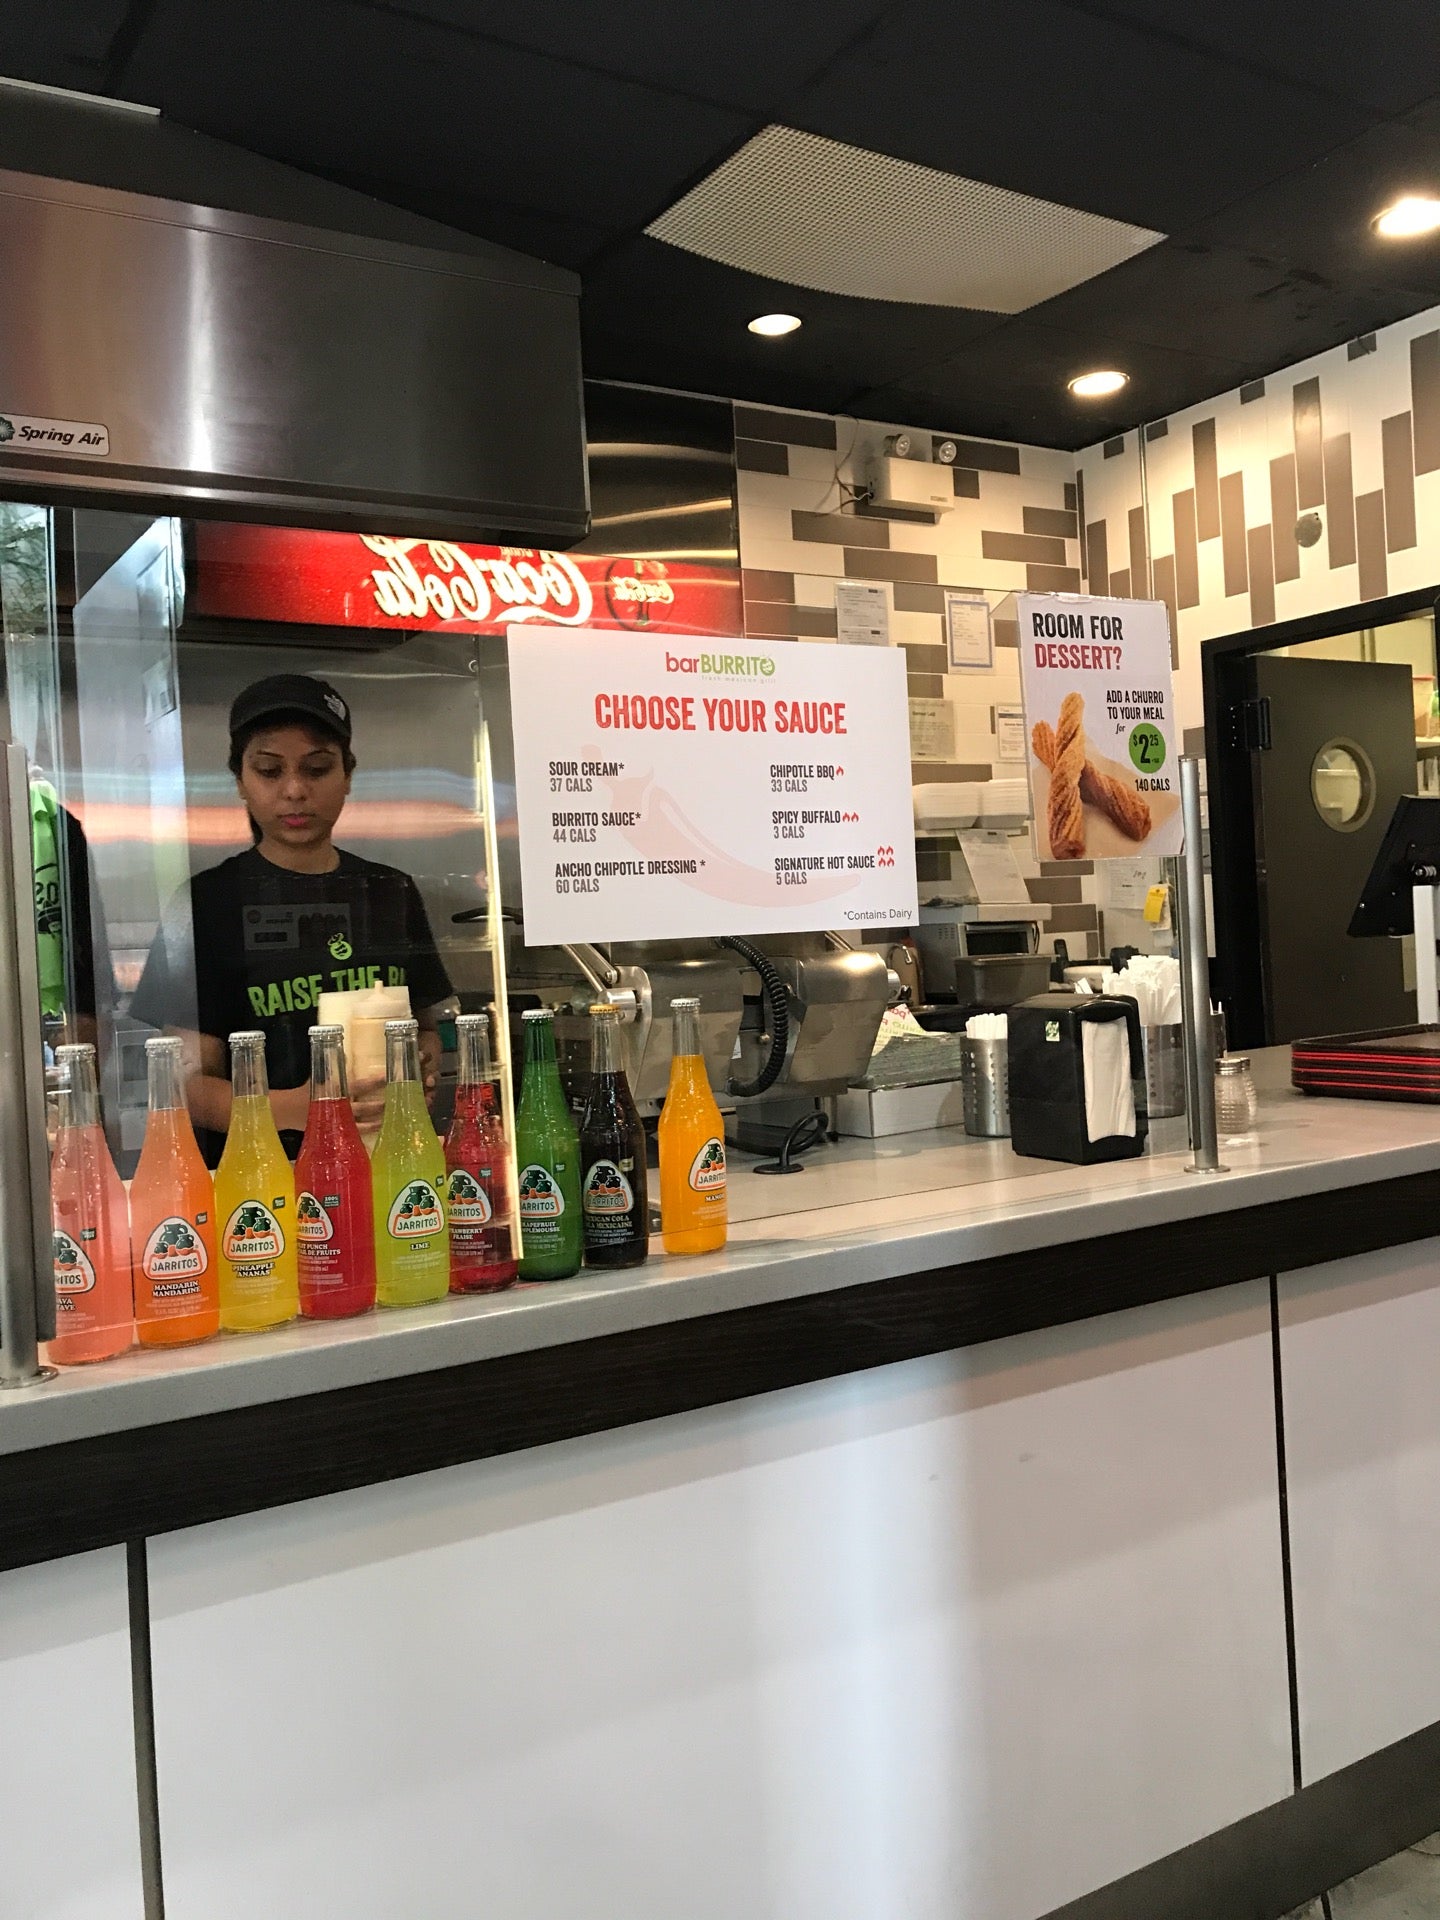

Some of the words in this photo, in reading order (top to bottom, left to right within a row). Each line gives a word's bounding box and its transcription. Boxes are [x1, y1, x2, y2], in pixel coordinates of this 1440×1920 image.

[18, 425, 75, 446] Spring
[78, 432, 105, 446] Air
[1032, 613, 1085, 639] ROOM
[1090, 615, 1123, 640] FOR
[1034, 643, 1122, 670] DESSERT?
[665, 651, 776, 677] barBURRITO
[1106, 690, 1123, 703] ADD
[1124, 690, 1131, 703] A
[1131, 690, 1164, 704] CHURRO
[594, 693, 696, 731] CHOOSE
[702, 697, 767, 732] YOUR
[774, 700, 847, 734] SAUCE
[1107, 706, 1118, 720] TO
[1120, 706, 1142, 720] YOUR
[1143, 707, 1165, 720] MEAL
[1115, 723, 1126, 735] for
[549, 761, 578, 776] SOUR
[770, 764, 814, 778] CHIPOTLE
[817, 765, 835, 780] BBQ
[550, 777, 563, 792] 37
[566, 777, 593, 792] CALS
[771, 779, 783, 792] 33
[785, 779, 808, 792] CALS
[1135, 779, 1149, 792] 140
[1150, 778, 1170, 792] CALS
[552, 812, 599, 827] BURRITO
[772, 811, 799, 824] SPICY
[801, 810, 841, 824] BUFFALO
[553, 828, 567, 843] 44
[569, 828, 597, 843] CALS
[773, 825, 780, 839] 3
[782, 825, 805, 839] CALS
[555, 862, 592, 878] ANCHO
[594, 861, 645, 877] CHIPOTLE
[647, 859, 697, 875] DRESSING
[774, 857, 825, 871] SIGNATURE
[827, 856, 845, 870] HOT
[847, 855, 875, 869] SAUCE
[776, 872, 782, 885] 5
[784, 871, 807, 885] CALS
[555, 879, 570, 894] 60
[573, 878, 600, 893] CALS
[889, 908, 912, 920] Dairy
[247, 974, 323, 1017] RAISE
[331, 965, 381, 992] THE
[521, 1202, 555, 1211] ARRITOS
[397, 1217, 438, 1231] JARRITOS
[230, 1241, 275, 1253] JARRITOS
[411, 1242, 429, 1250] LIME
[152, 1258, 198, 1272] JARRITOS
[233, 1263, 275, 1271] PINEAPPLE
[238, 1269, 271, 1277] ANANAS
[153, 1287, 200, 1297] MANDARINE
[154, 1281, 199, 1291] MANDARIN
